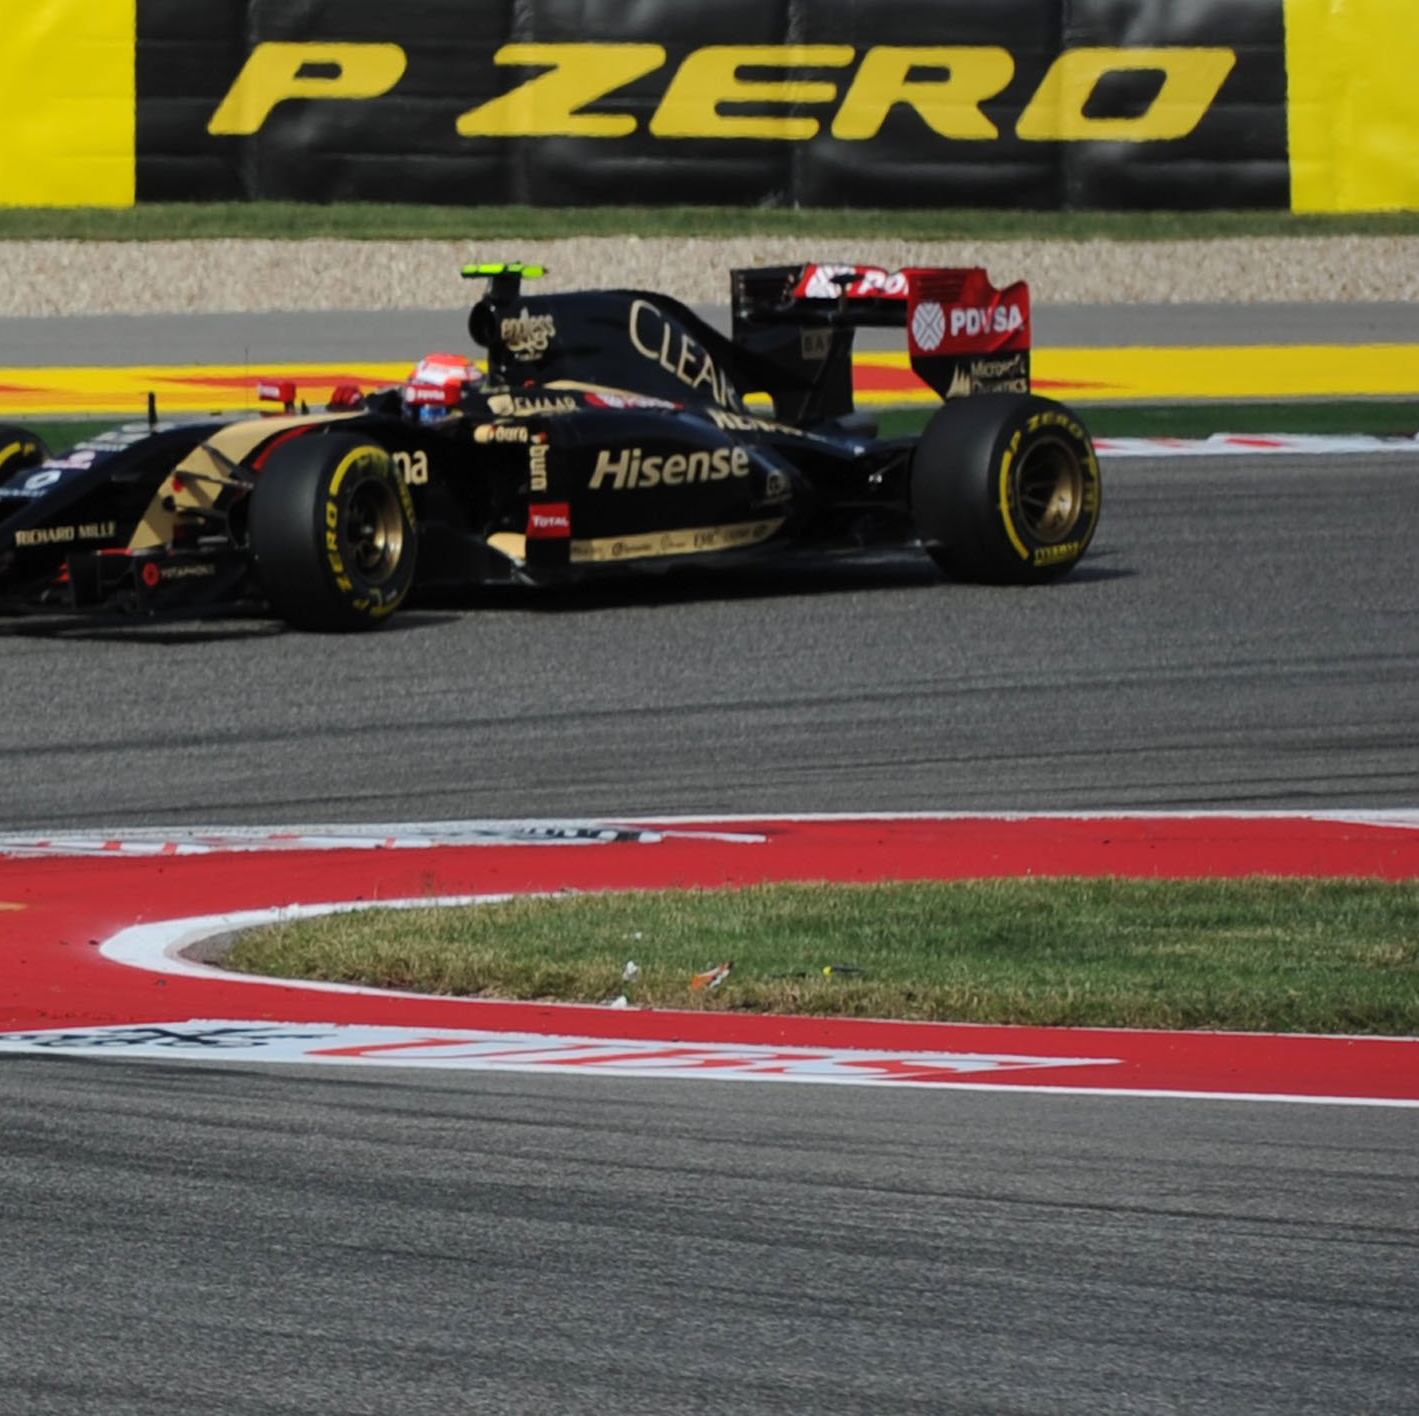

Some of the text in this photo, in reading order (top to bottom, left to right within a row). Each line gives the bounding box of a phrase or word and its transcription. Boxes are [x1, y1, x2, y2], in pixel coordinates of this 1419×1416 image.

[207, 42, 1237, 141] P ZERO
[950, 304, 1024, 337] PDVSA
[587, 446, 750, 490] Hisense
[15, 521, 116, 548] RICHARD MILLE
[533, 514, 569, 528] TOTAL
